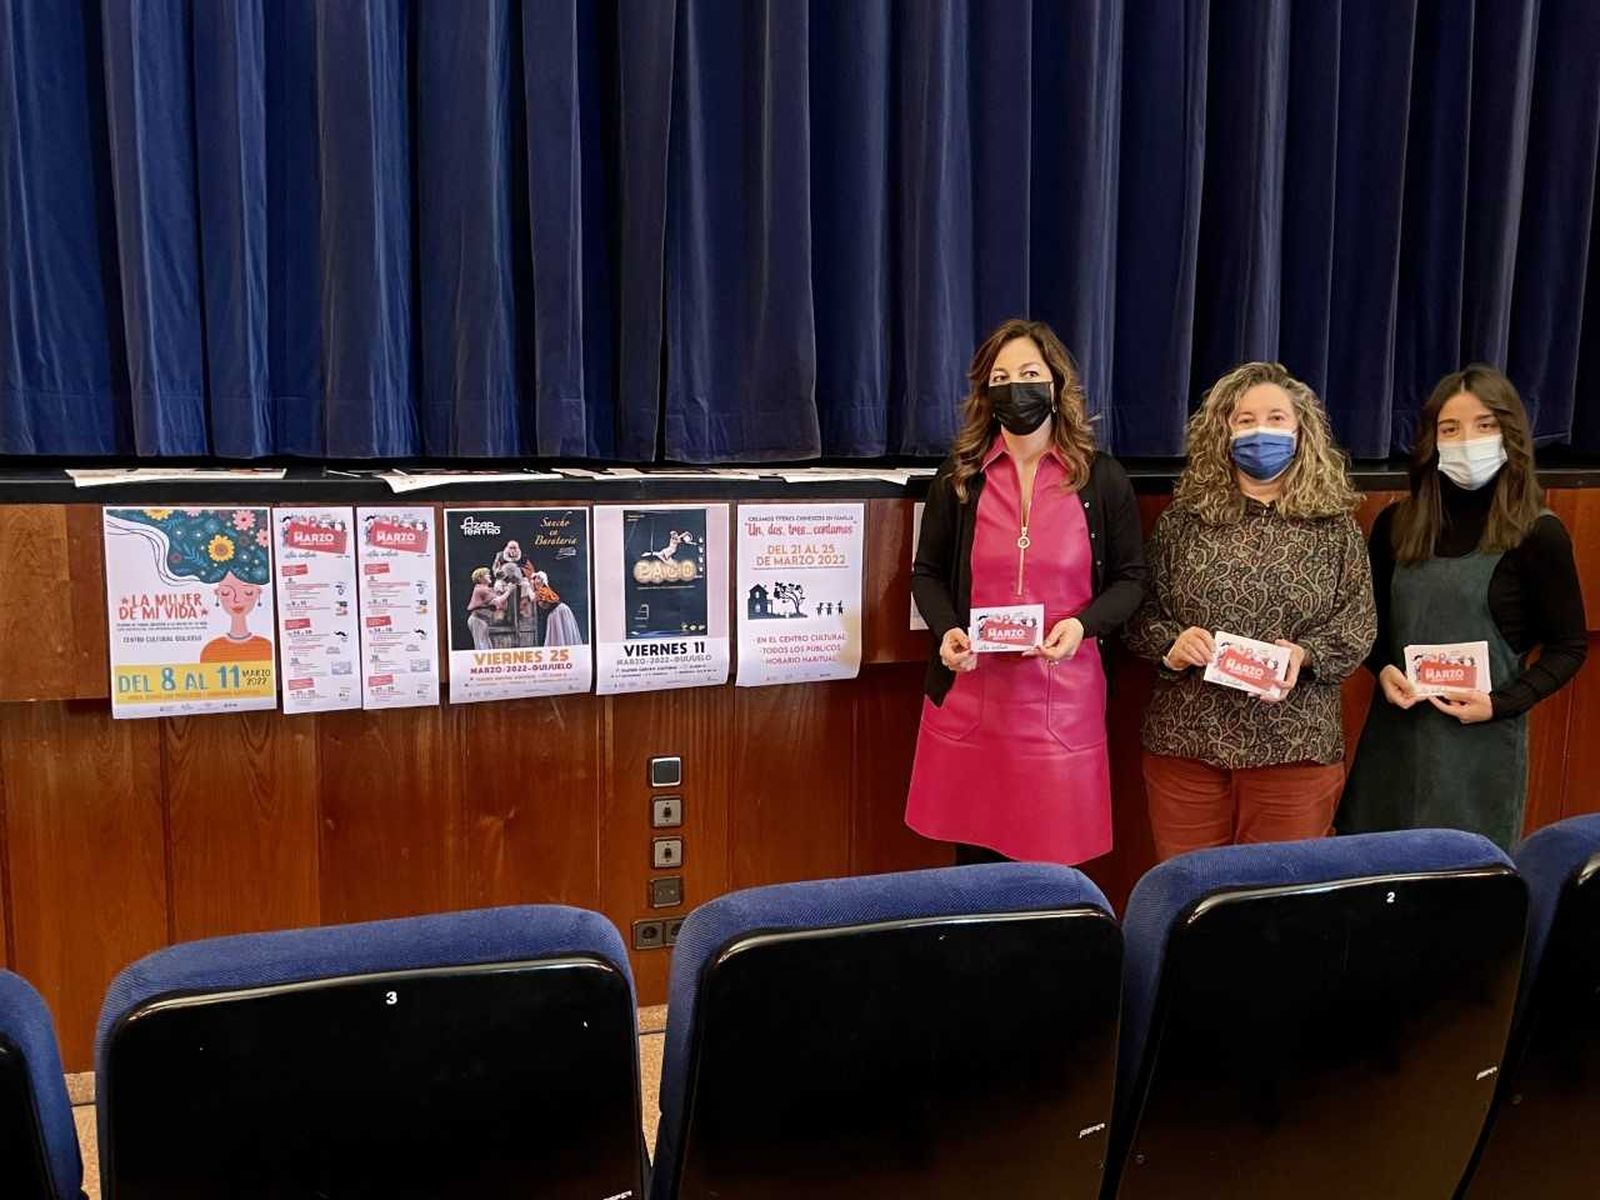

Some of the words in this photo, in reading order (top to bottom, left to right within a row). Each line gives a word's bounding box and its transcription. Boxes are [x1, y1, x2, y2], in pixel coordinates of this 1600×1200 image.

[293, 531, 334, 542] MARZO
[376, 530, 416, 541] MARZO
[767, 545, 789, 555] DEL
[791, 544, 801, 554] 21
[804, 544, 817, 554] AL
[822, 544, 835, 553] 25
[756, 556, 770, 566] DE
[774, 555, 814, 565] MARZO
[817, 555, 846, 565] 2022
[131, 594, 150, 607] LA
[158, 592, 202, 607] MUJER
[119, 607, 137, 620] DE
[141, 606, 160, 619] MI
[162, 605, 198, 619] VIDA
[780, 635, 809, 643] CENTRO
[987, 628, 1026, 638] MARZO
[623, 642, 688, 657] VIERNES
[694, 642, 705, 653] 11
[474, 650, 543, 665] VIERNES
[550, 649, 569, 662] 25
[242, 668, 271, 678] MARZO
[1225, 658, 1265, 677] MARZO
[1425, 667, 1465, 680] MARZO
[118, 674, 153, 693] DEL
[161, 666, 176, 691] 8
[185, 672, 209, 690] AL
[216, 664, 240, 689] 11
[1386, 891, 1396, 903] 2
[386, 991, 398, 1005] 3
